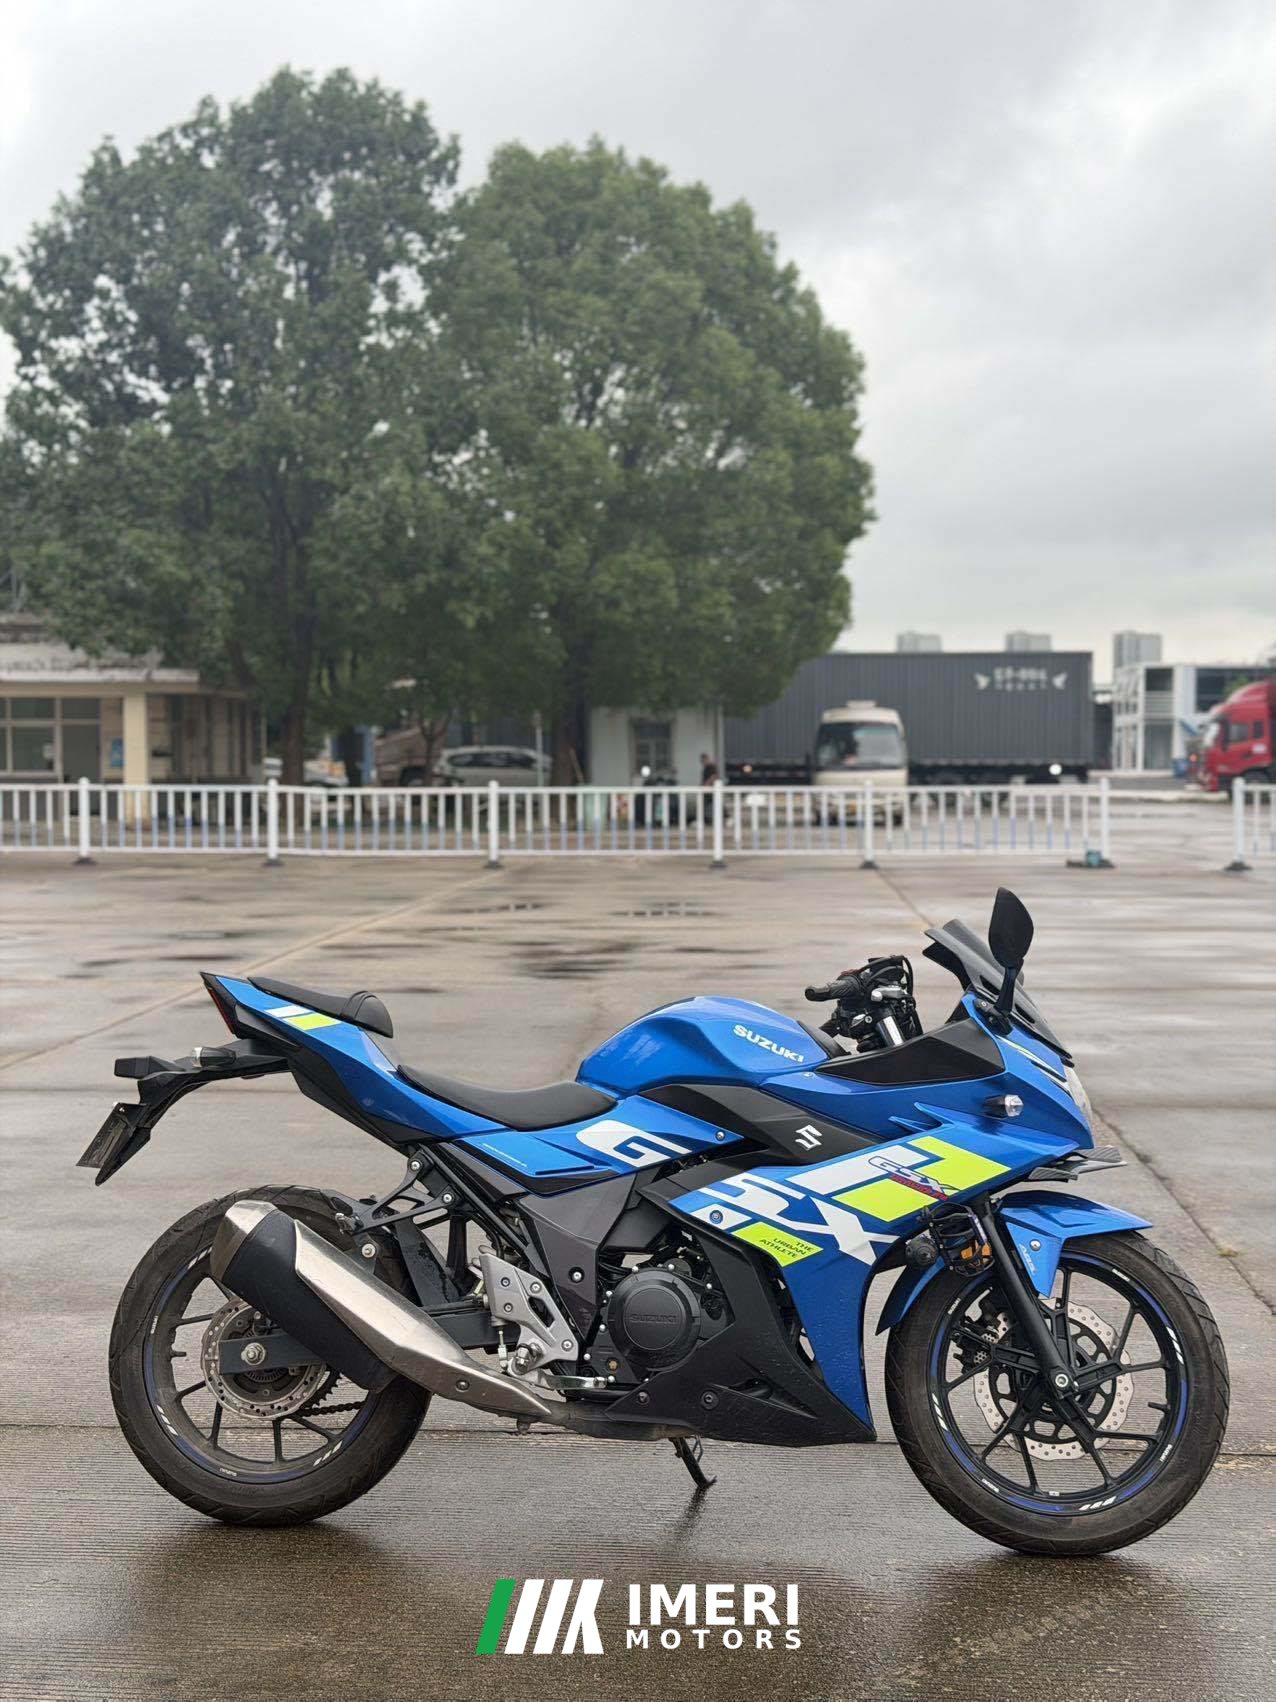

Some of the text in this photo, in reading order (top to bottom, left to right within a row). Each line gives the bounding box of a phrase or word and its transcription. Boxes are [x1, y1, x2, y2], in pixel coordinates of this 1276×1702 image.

[733, 1024, 804, 1063] SUZUKI
[760, 1239, 796, 1258] ATHLETE
[773, 1238, 807, 1255] URBAN
[796, 1241, 814, 1252] THE
[629, 1313, 677, 1325] SUZUKI
